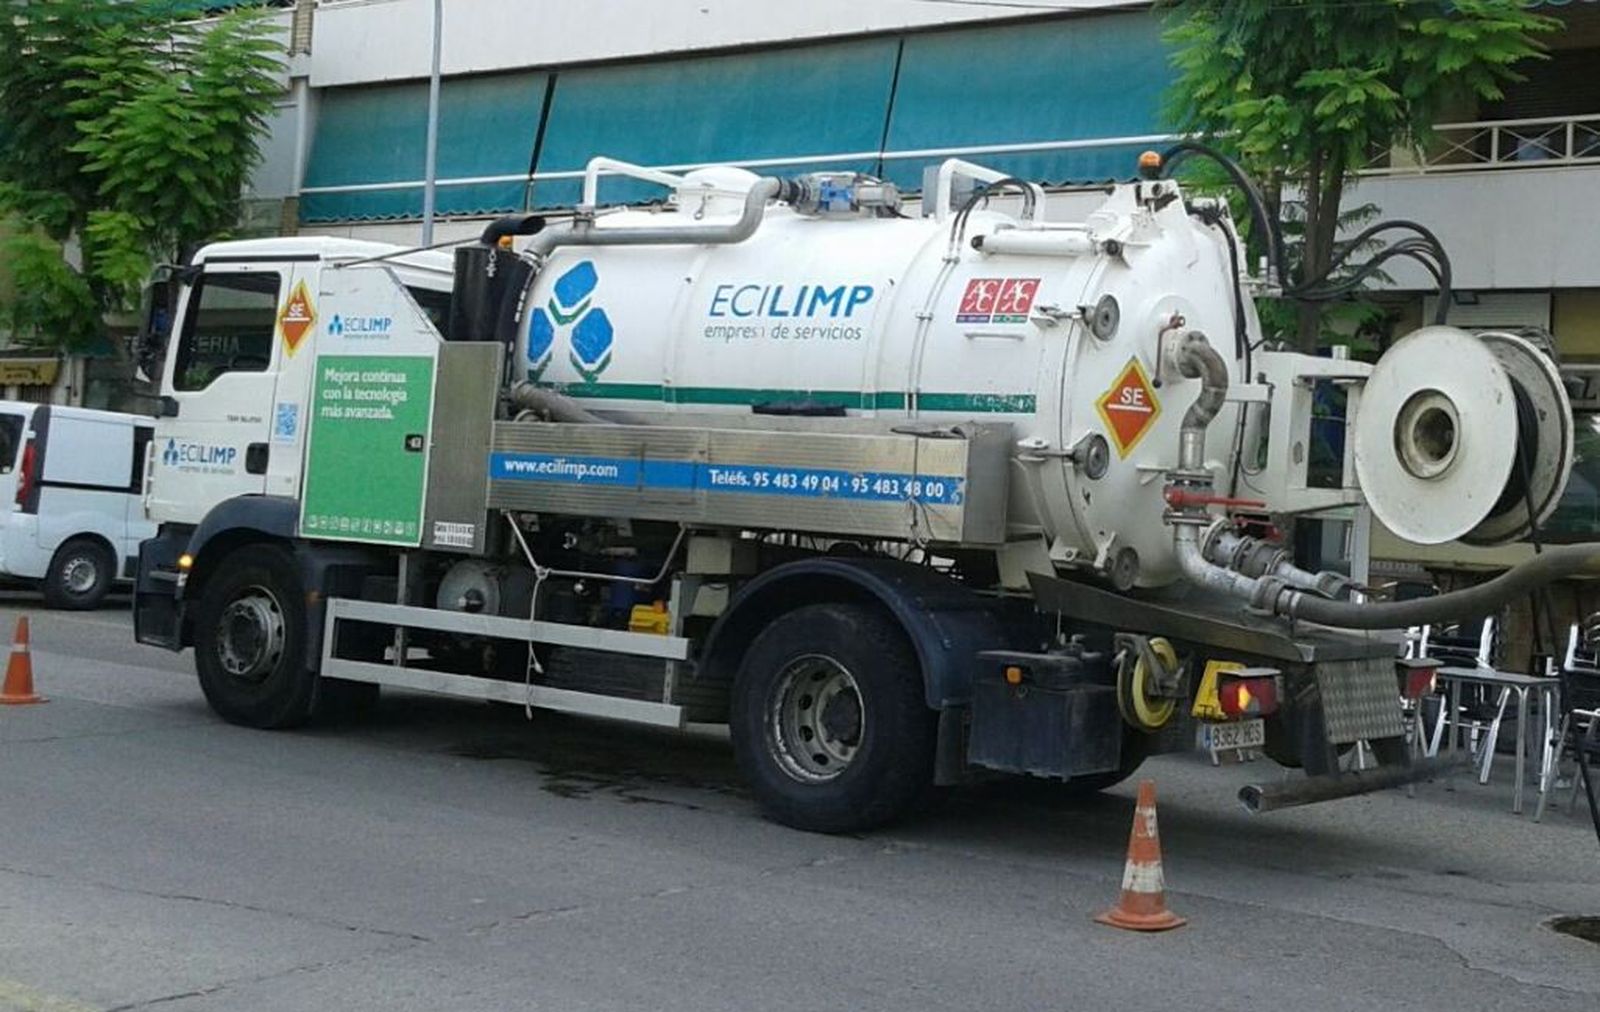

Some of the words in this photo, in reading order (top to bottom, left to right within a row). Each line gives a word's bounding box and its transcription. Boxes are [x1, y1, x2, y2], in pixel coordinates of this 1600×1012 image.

[289, 303, 305, 317] SE
[709, 285, 874, 317] ECILIMP
[344, 317, 392, 331] ECILIMP
[771, 323, 790, 340] de
[794, 324, 862, 340] servicios
[325, 368, 359, 385] Mejora
[323, 389, 341, 400] con
[343, 386, 352, 400] la
[1121, 386, 1144, 406] SE
[180, 444, 236, 464] ECILIMP
[504, 459, 618, 480] www.ecilimp.com
[709, 469, 750, 486] Teléfs.
[753, 472, 770, 487] 95
[773, 472, 798, 489] 483
[802, 474, 818, 491] 49
[822, 475, 839, 492] 04
[851, 478, 869, 493] 95
[873, 478, 899, 496] 483
[903, 480, 921, 497] 48
[926, 482, 944, 498] 00
